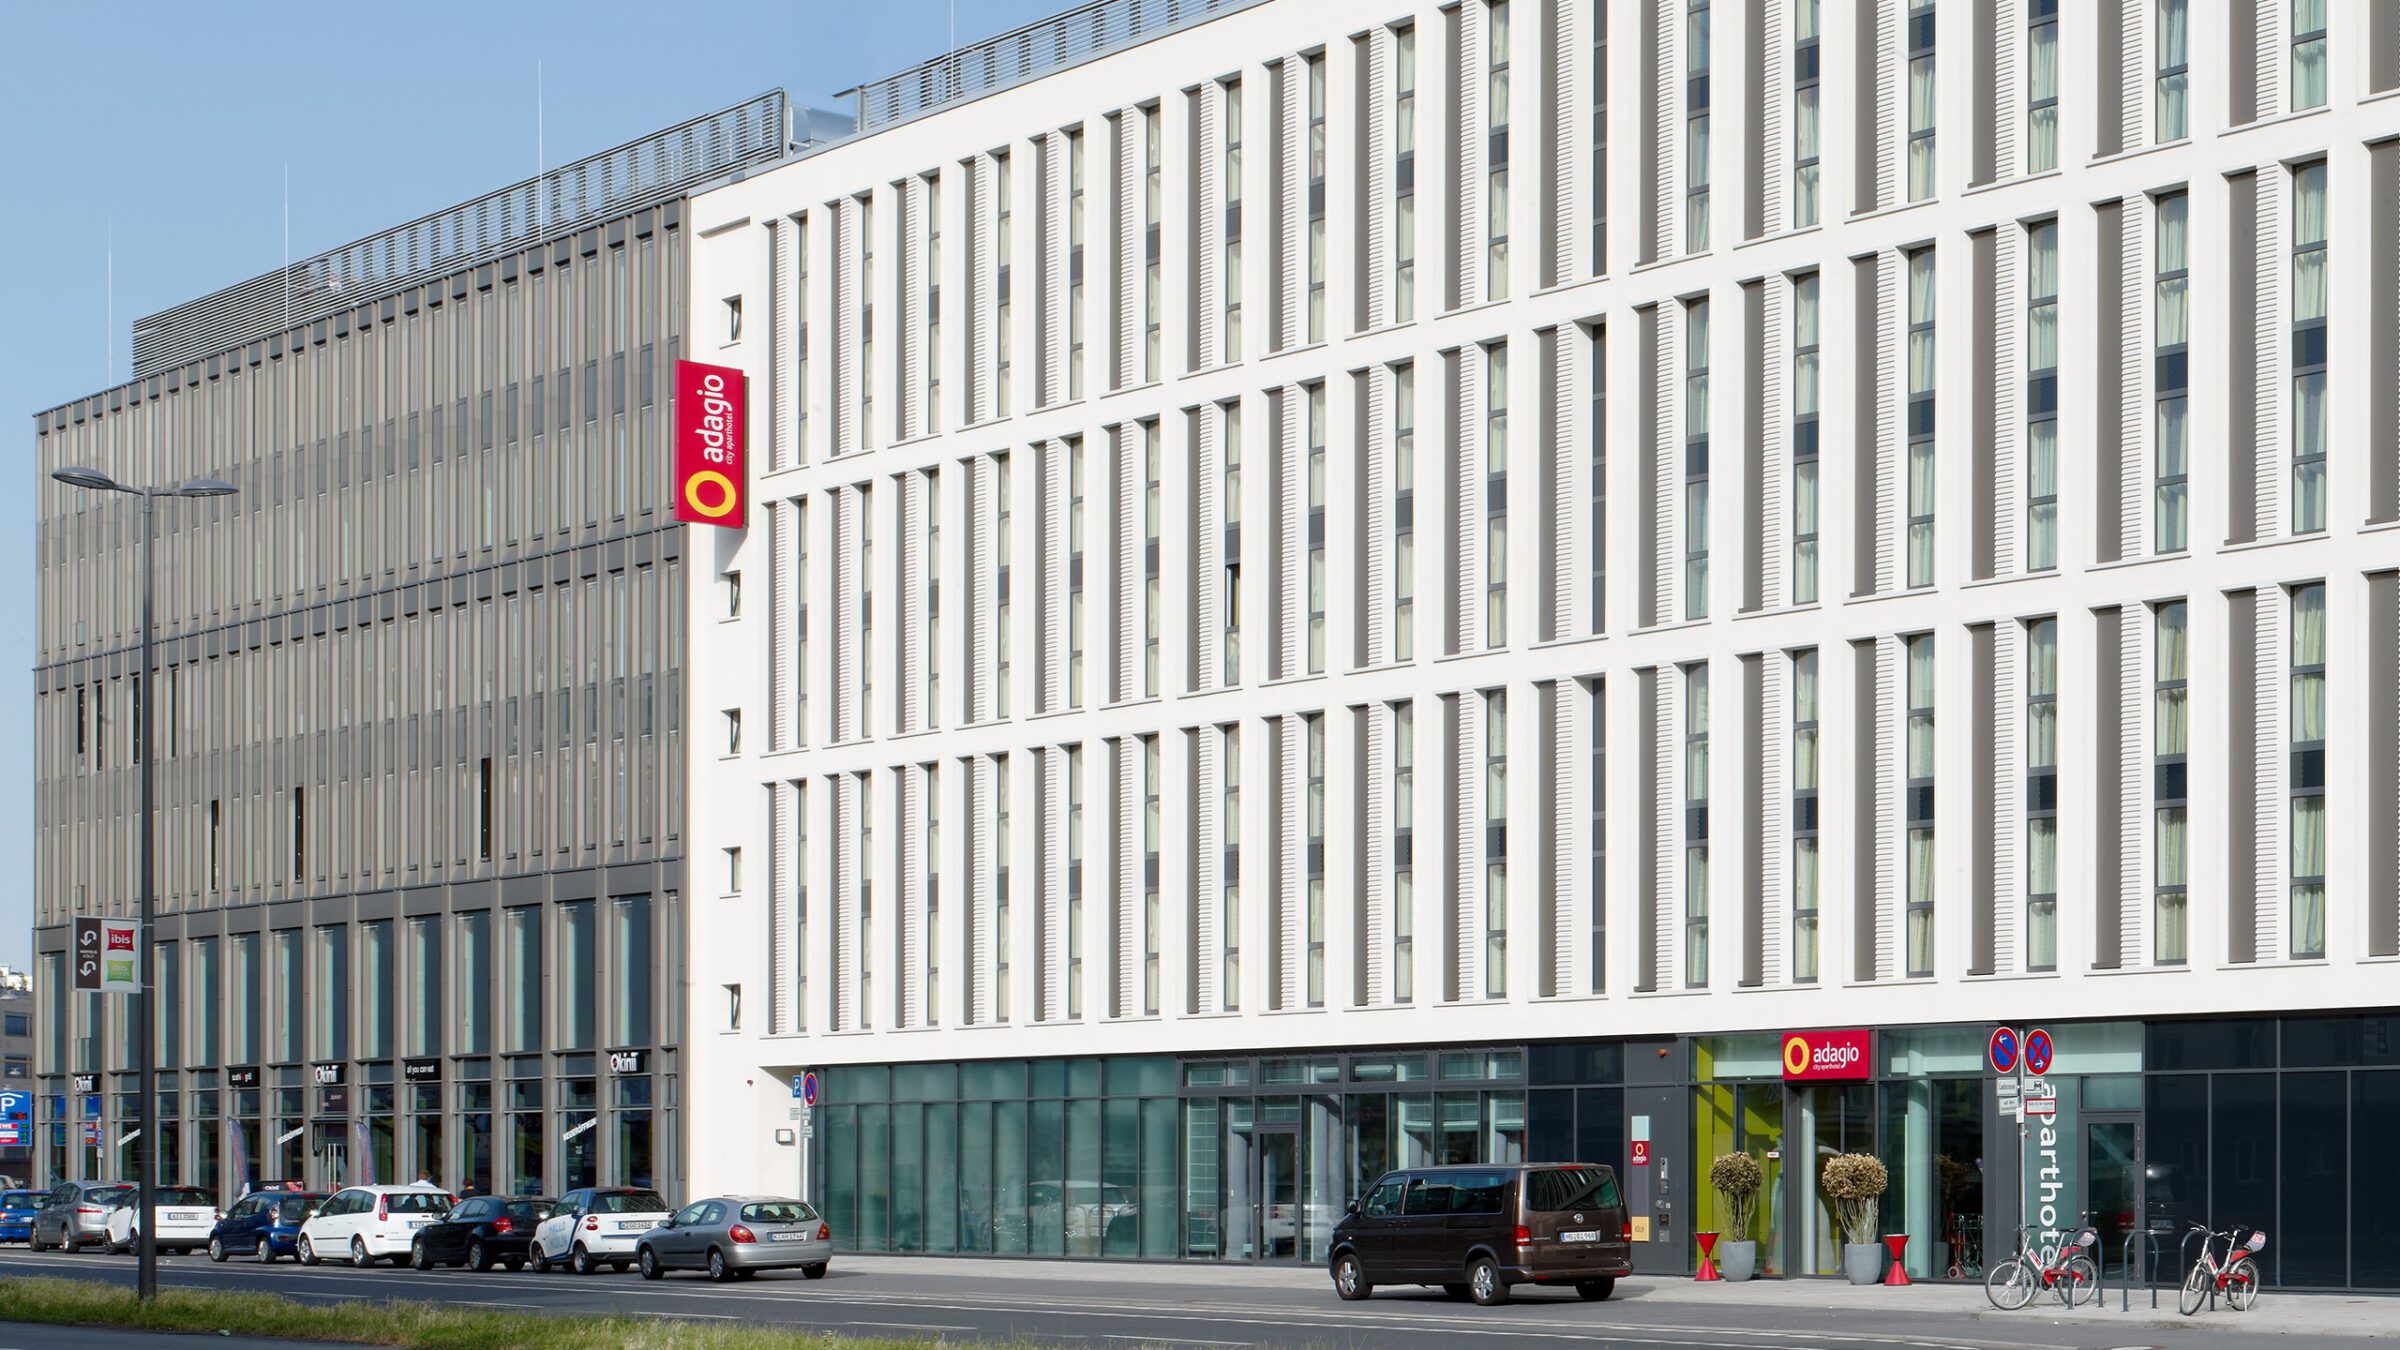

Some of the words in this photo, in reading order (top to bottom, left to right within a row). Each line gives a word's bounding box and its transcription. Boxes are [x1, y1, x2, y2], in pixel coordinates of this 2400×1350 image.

[695, 374, 733, 464] adagio
[725, 412, 733, 450] aparthotel
[725, 450, 735, 465] city
[111, 934, 131, 944] ibis
[1813, 1041, 1859, 1068] adagio
[1, 1097, 16, 1112] P
